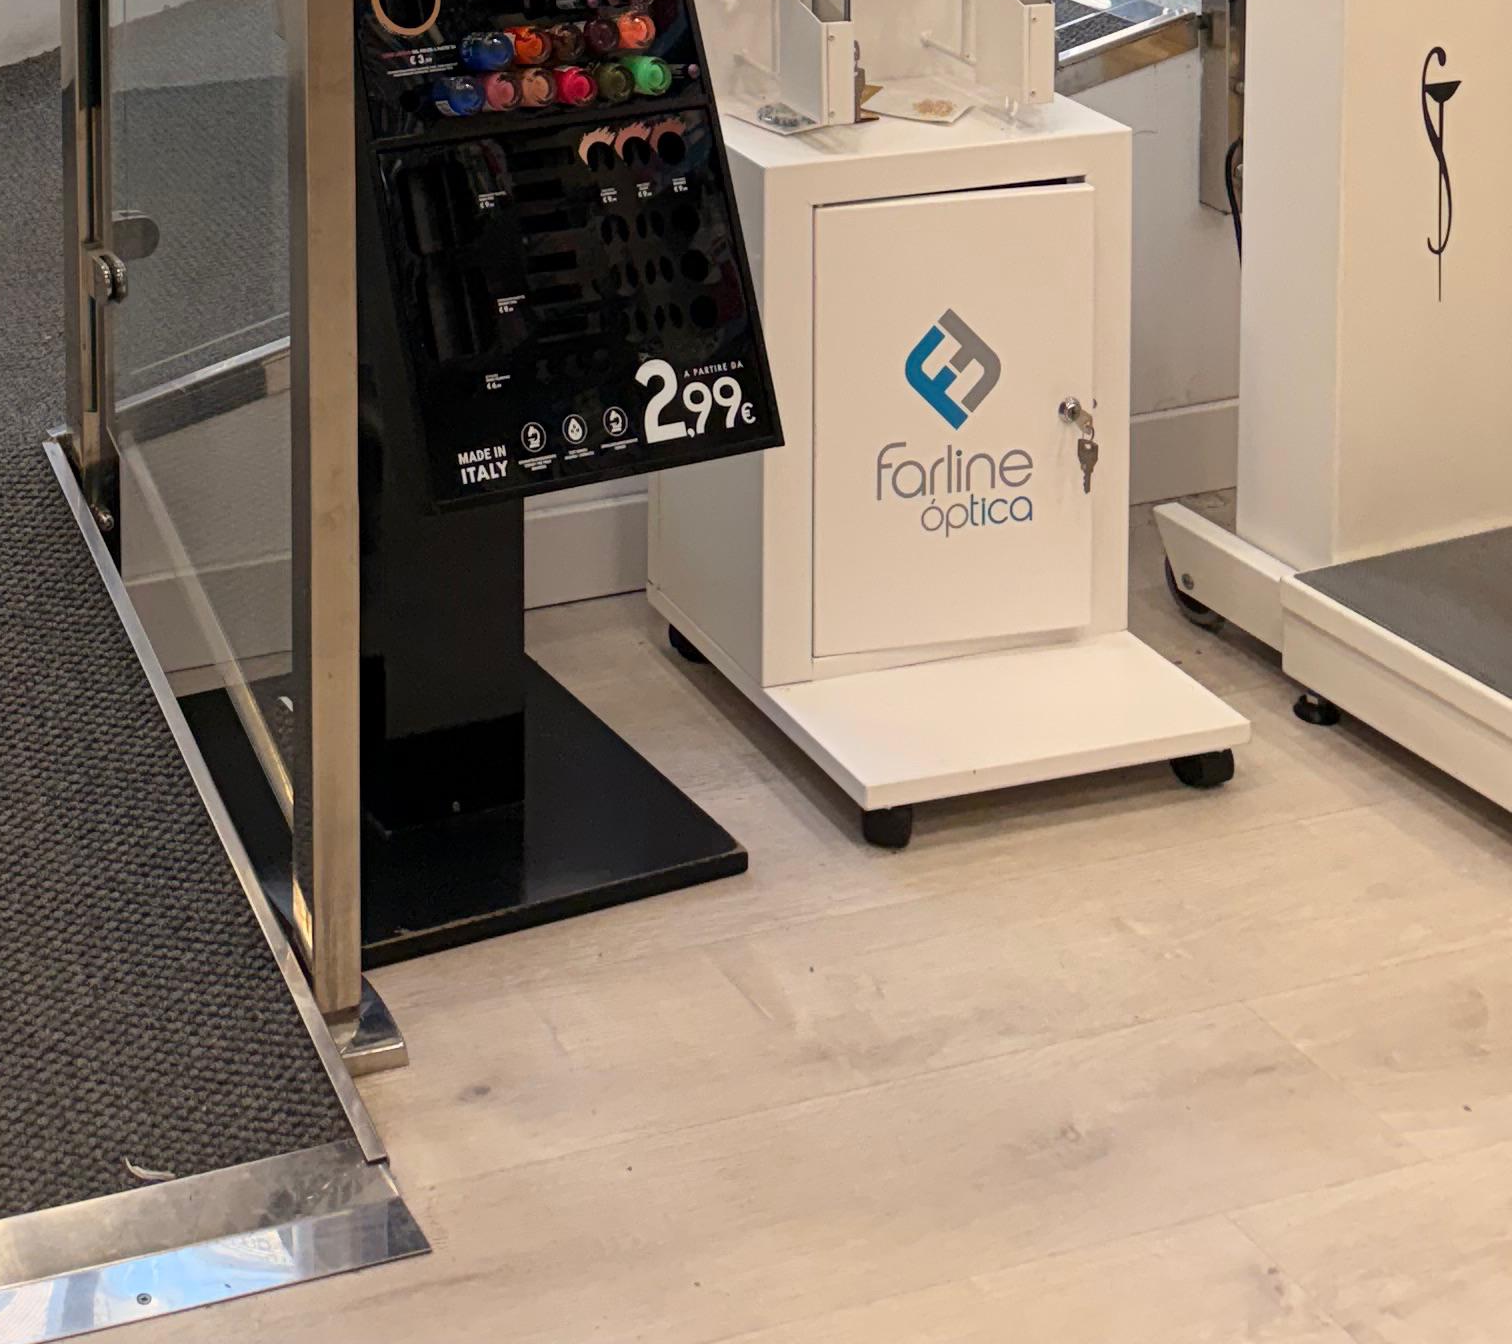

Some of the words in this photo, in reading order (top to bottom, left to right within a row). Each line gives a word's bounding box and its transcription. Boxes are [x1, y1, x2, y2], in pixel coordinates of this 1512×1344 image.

[682, 369, 691, 379] A
[691, 362, 728, 377] PARTIRE
[730, 360, 744, 372] DA
[458, 448, 492, 466] MADE
[493, 445, 507, 459] IN
[460, 460, 509, 485] ITALY
[876, 441, 1034, 501] farline
[921, 493, 1034, 538] óptica
